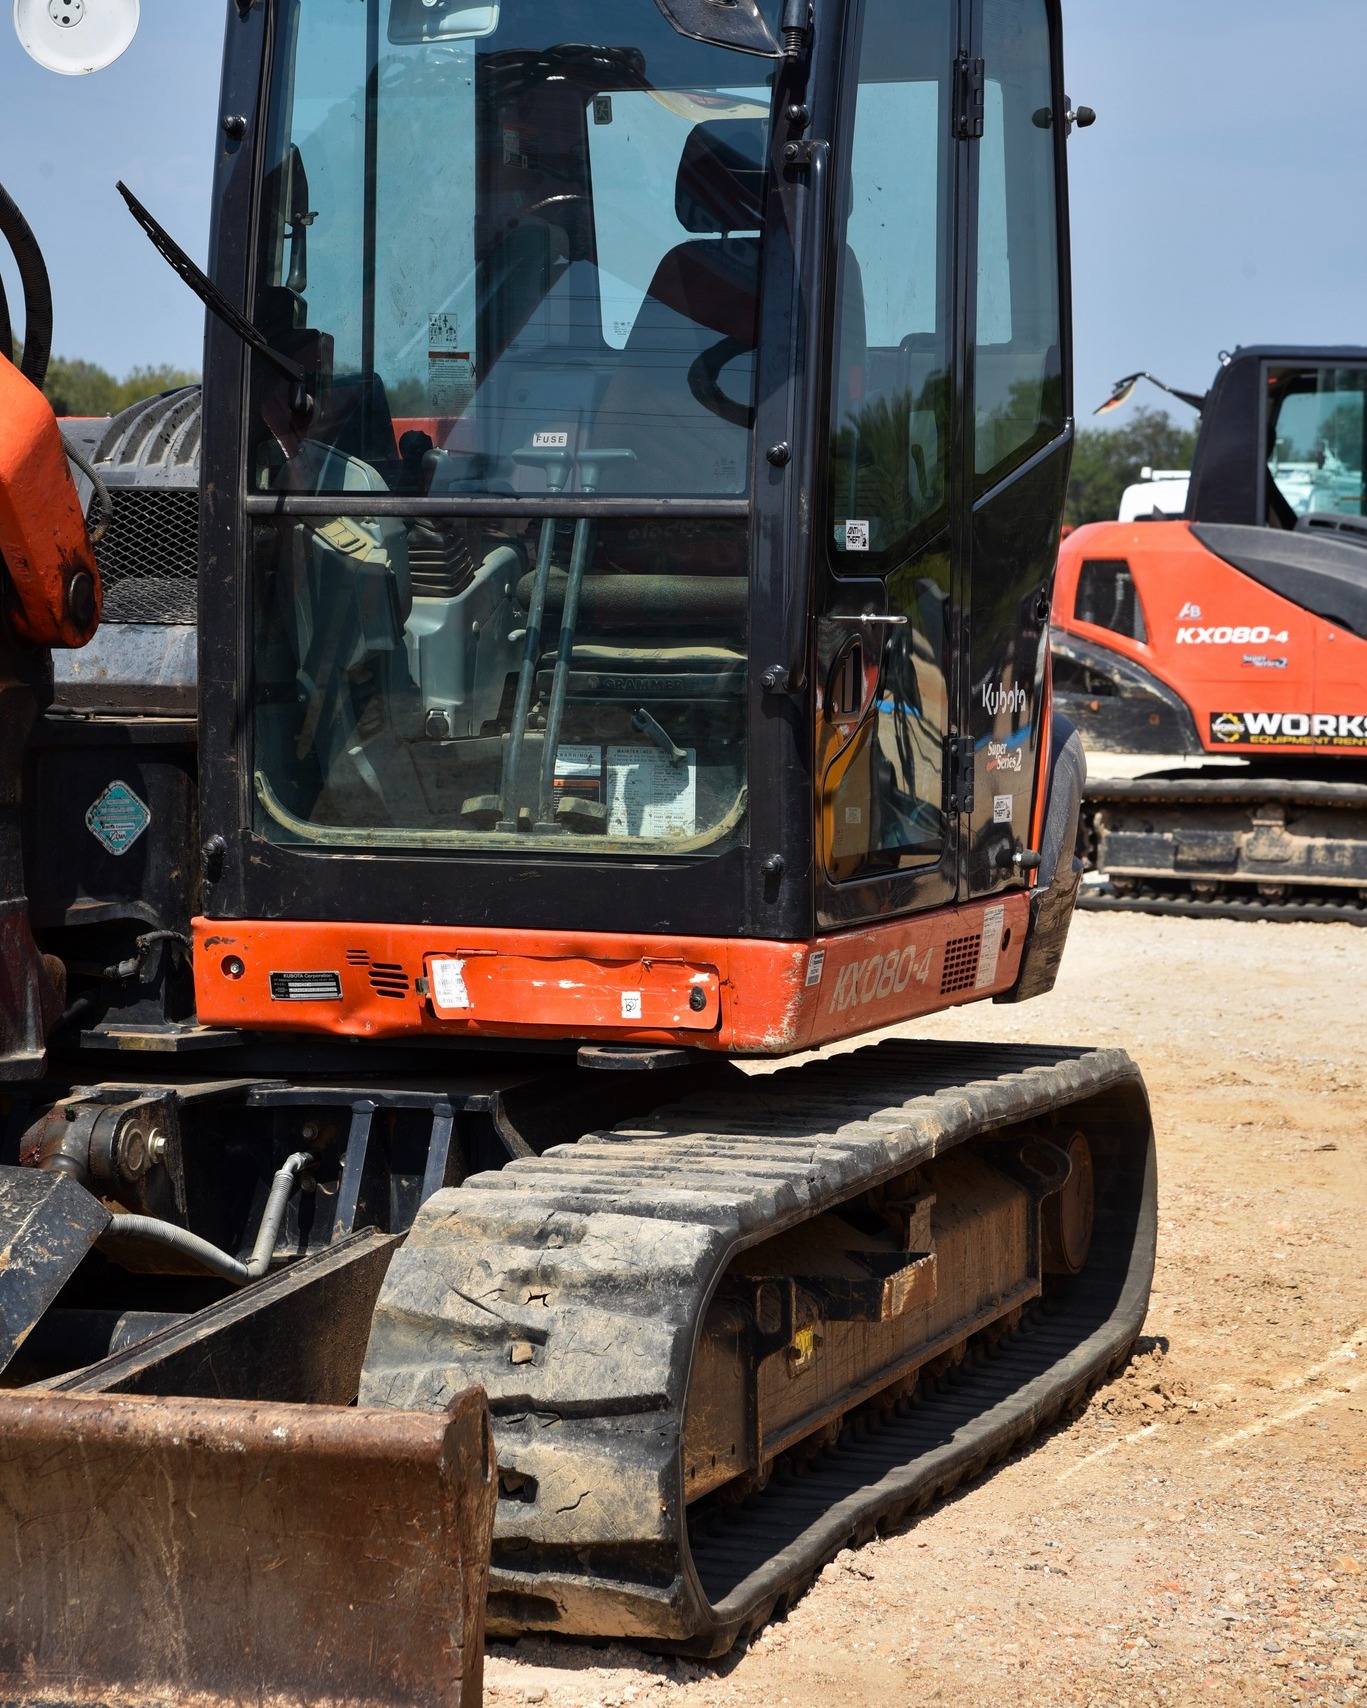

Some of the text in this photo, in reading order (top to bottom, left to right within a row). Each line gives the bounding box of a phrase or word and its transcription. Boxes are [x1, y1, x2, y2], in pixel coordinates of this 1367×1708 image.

[536, 434, 565, 444] FUSE
[1176, 627, 1288, 644] KX080-4
[603, 678, 684, 690] GRAMMER
[982, 681, 1026, 715] Kubota
[1243, 713, 1367, 737] WORK
[1250, 734, 1329, 745] EQUIPMENT
[988, 741, 1007, 759] Super
[829, 945, 933, 1013] KX080-4
